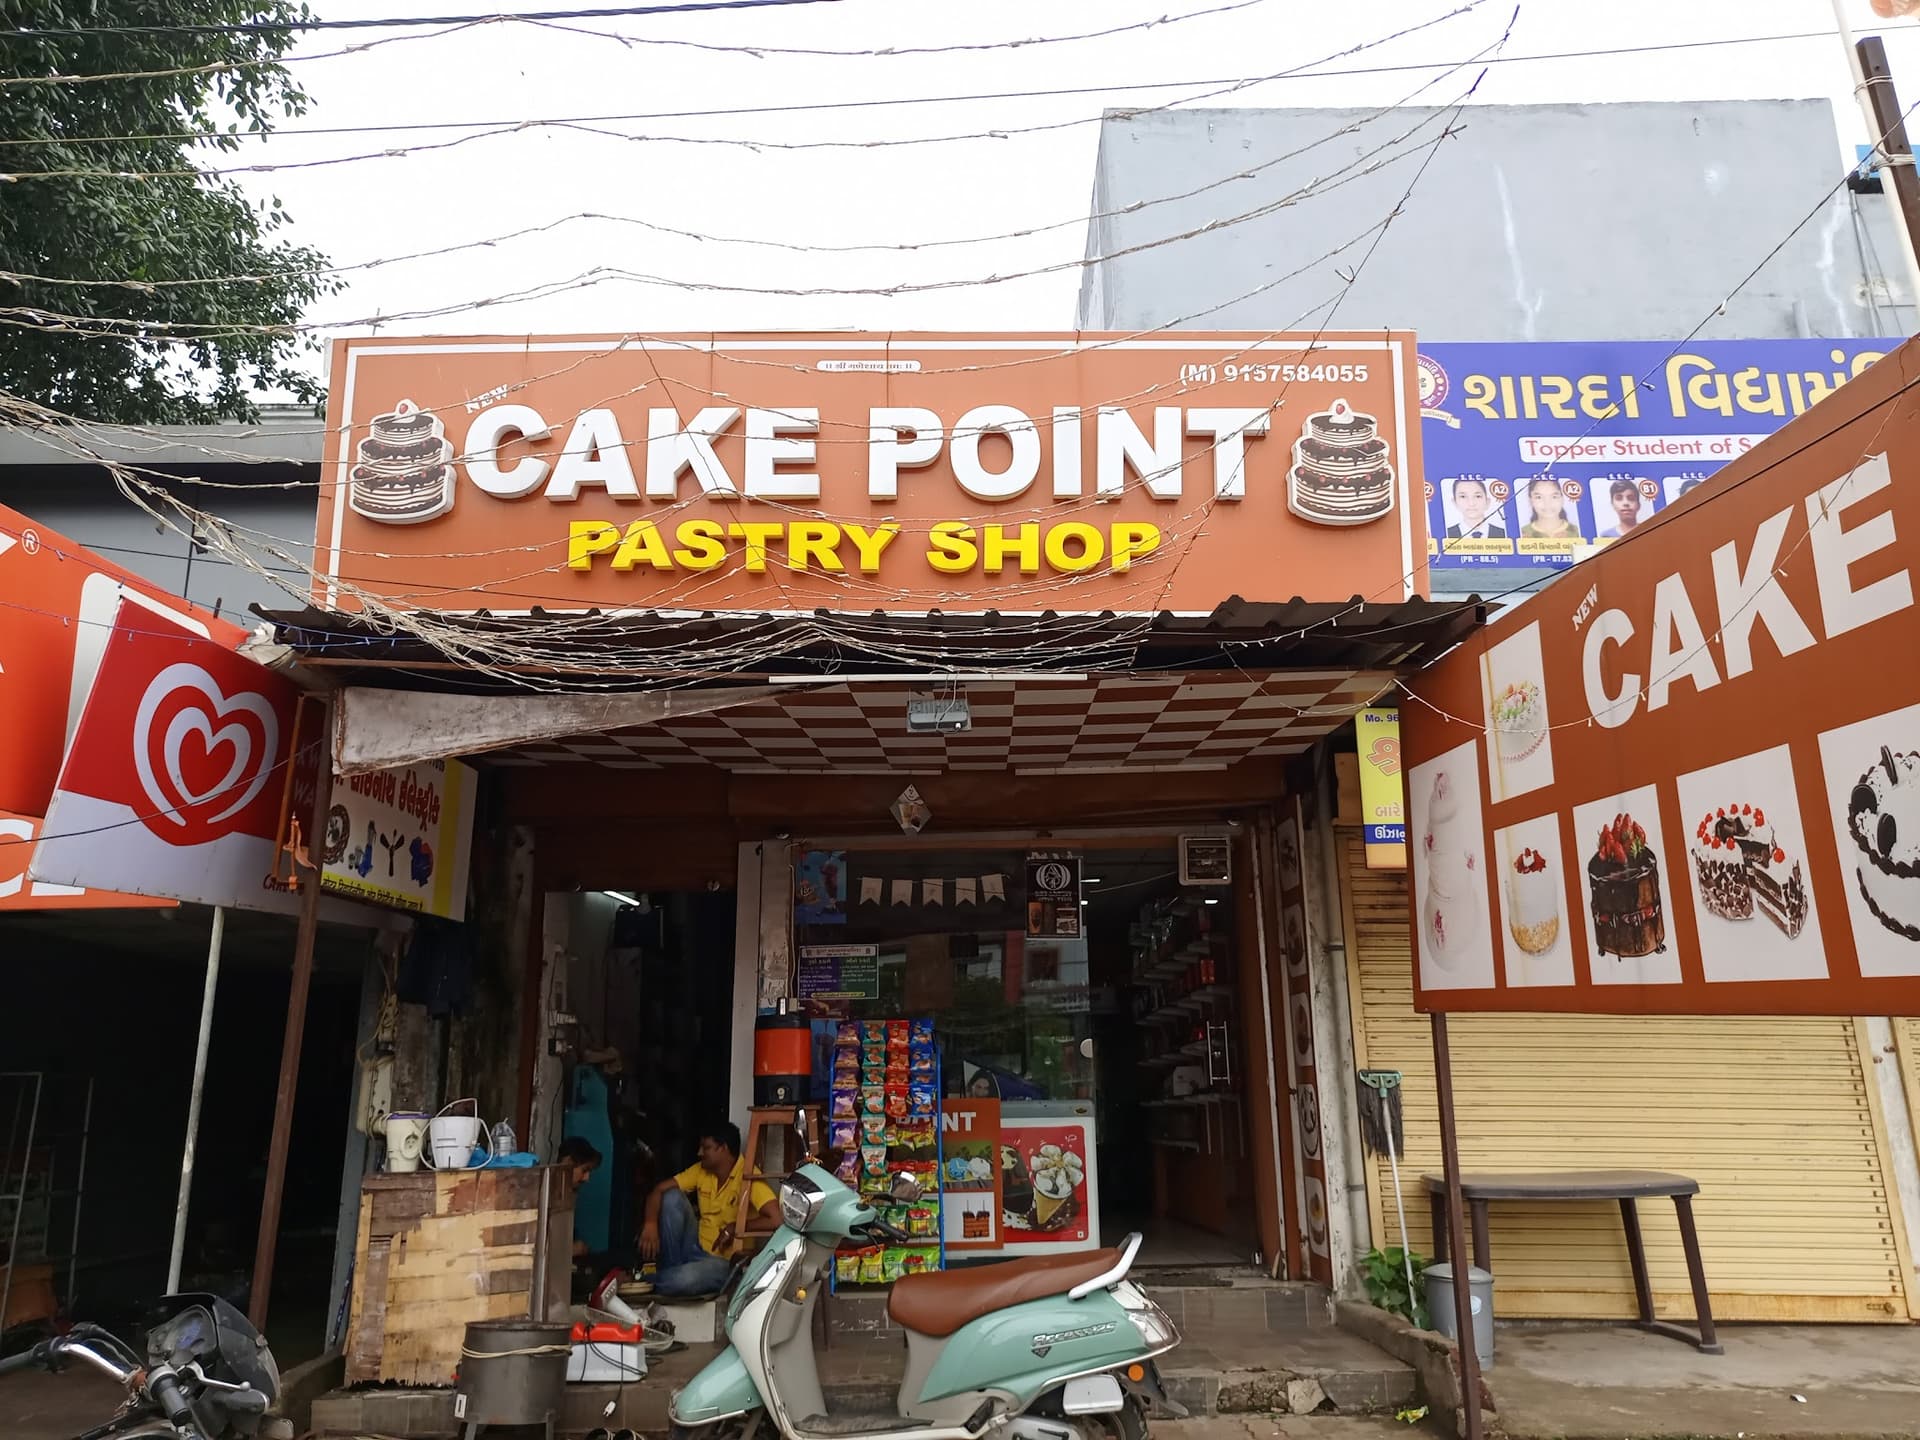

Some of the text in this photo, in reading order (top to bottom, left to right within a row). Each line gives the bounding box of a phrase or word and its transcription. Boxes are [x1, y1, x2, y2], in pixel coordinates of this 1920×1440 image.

[1180, 364, 1368, 386] (M) 9157584055
[1462, 374, 1641, 419] શારદા
[464, 384, 508, 414] NEW
[464, 404, 1272, 502] CAKE POINT
[1525, 439, 1607, 460] Topper
[1614, 438, 1703, 456] Student
[1710, 437, 1732, 454] of
[567, 520, 1162, 574] PASTRY SHOP
[1571, 583, 1598, 632] NEW
[1583, 451, 1914, 729] CAKE
[1365, 714, 1384, 723] Mo.
